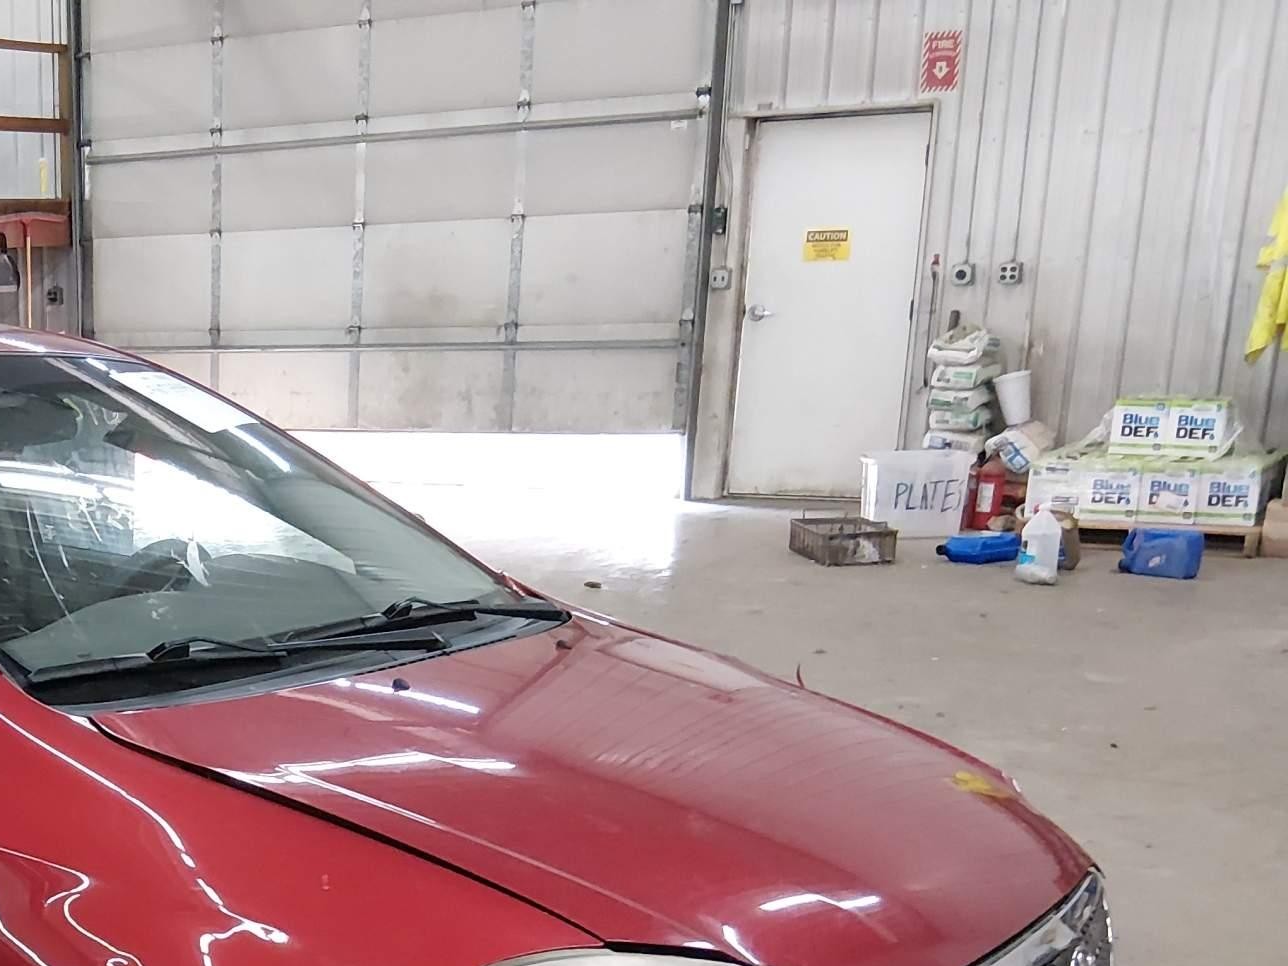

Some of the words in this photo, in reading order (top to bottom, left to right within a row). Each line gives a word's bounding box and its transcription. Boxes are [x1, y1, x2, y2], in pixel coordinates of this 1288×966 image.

[808, 231, 847, 241] CAUTION
[1122, 413, 1160, 425] Blue
[1177, 415, 1217, 427] Blue
[1120, 426, 1159, 438] DEF
[1175, 427, 1215, 440] DEF
[1092, 479, 1131, 491] Blue
[1150, 480, 1190, 493] Blue
[1209, 481, 1250, 494] Blue
[1091, 491, 1130, 504] DEF
[1207, 494, 1249, 507] DEF
